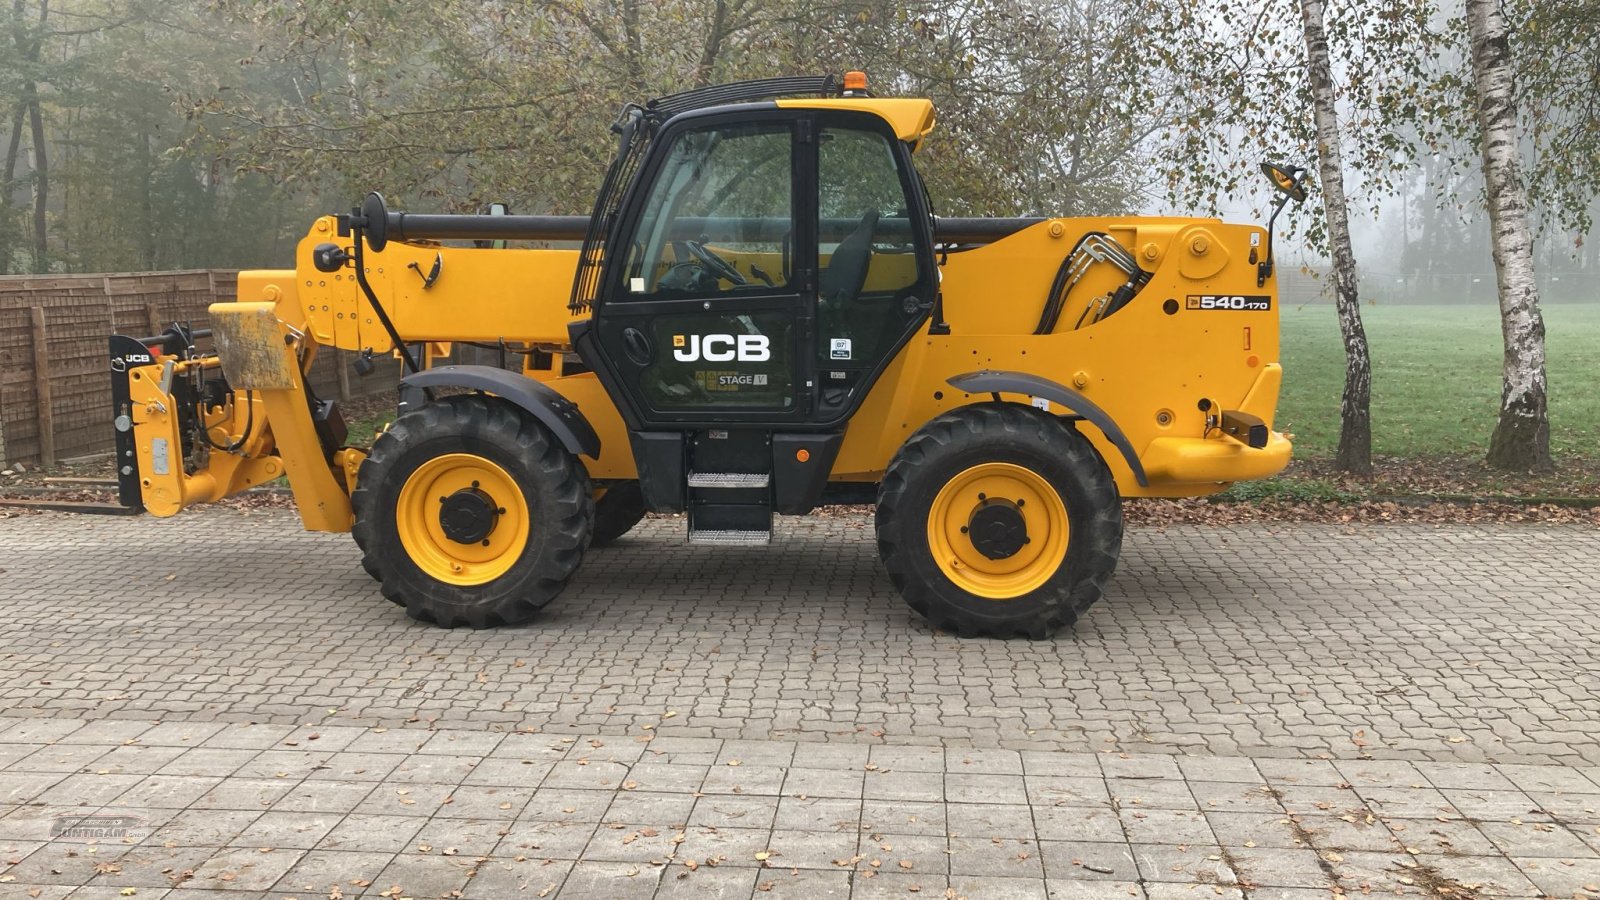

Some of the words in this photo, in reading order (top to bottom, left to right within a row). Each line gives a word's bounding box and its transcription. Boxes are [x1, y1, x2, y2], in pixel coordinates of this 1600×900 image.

[1200, 296, 1268, 310] 540-170
[673, 334, 770, 362] JCB
[125, 354, 150, 362] JCB
[719, 375, 752, 385] STAGE
